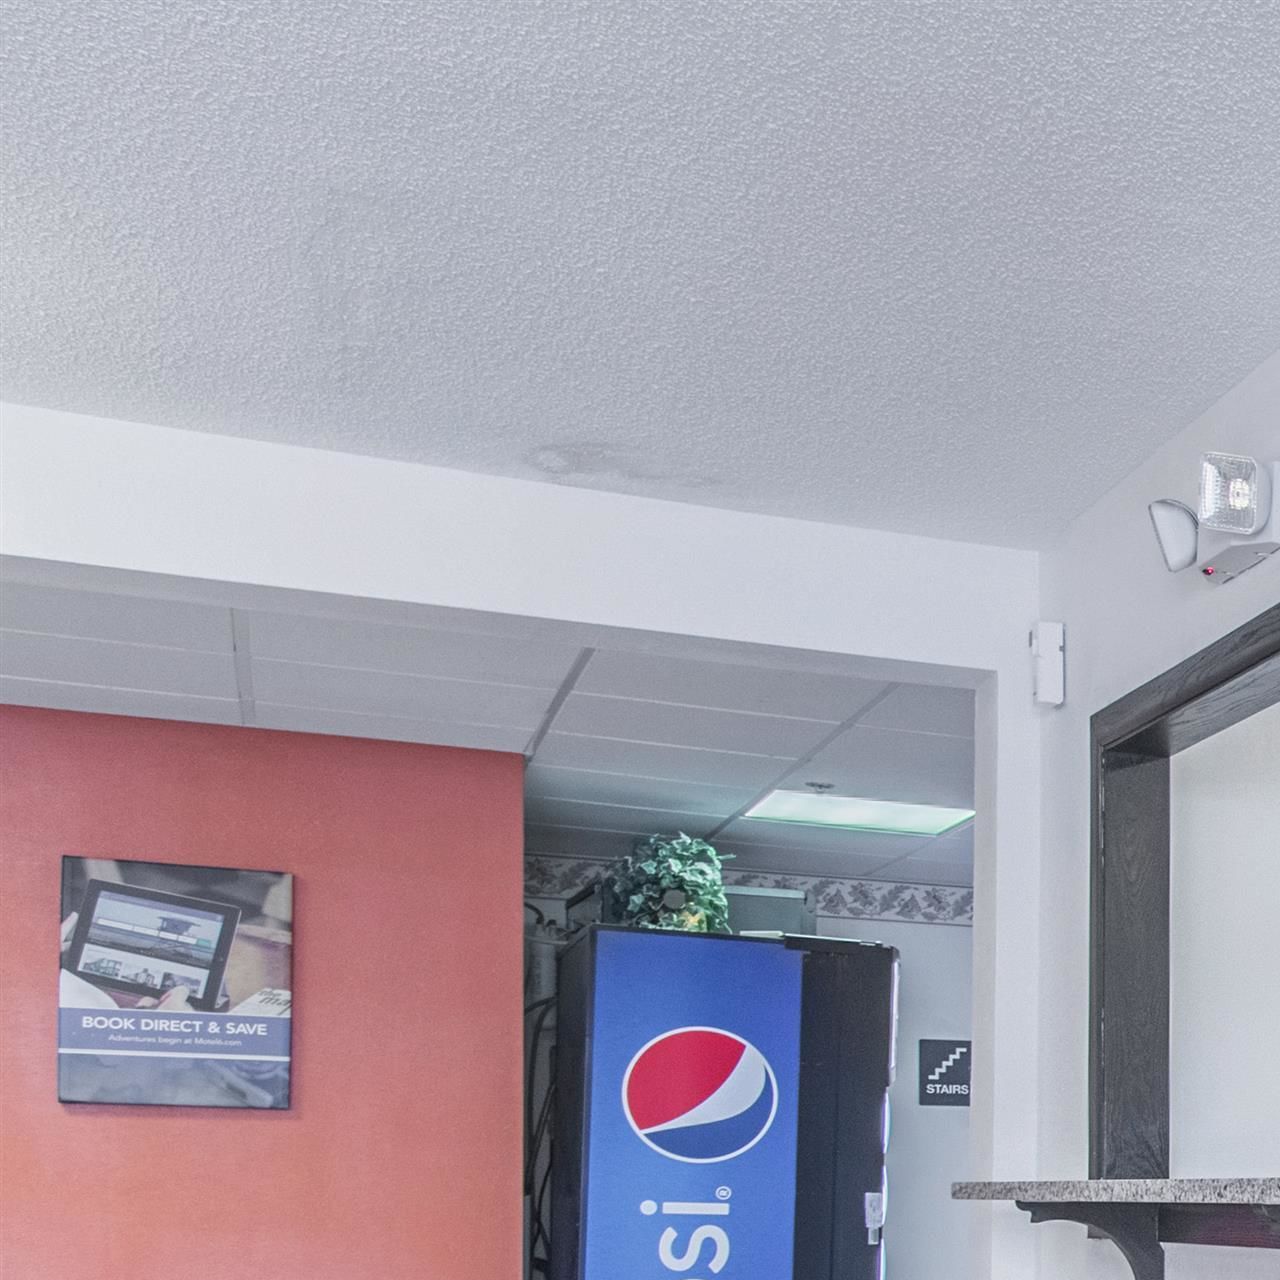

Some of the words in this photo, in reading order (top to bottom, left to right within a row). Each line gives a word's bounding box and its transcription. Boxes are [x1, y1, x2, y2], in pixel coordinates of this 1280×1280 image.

[82, 1016, 136, 1030] BOOK
[141, 1018, 203, 1033] DIRECT
[208, 1021, 220, 1034] &
[226, 1022, 268, 1036] SAVE
[108, 1033, 156, 1043] Adventures
[158, 1036, 182, 1046] begin
[926, 1084, 968, 1094] STAIRS
